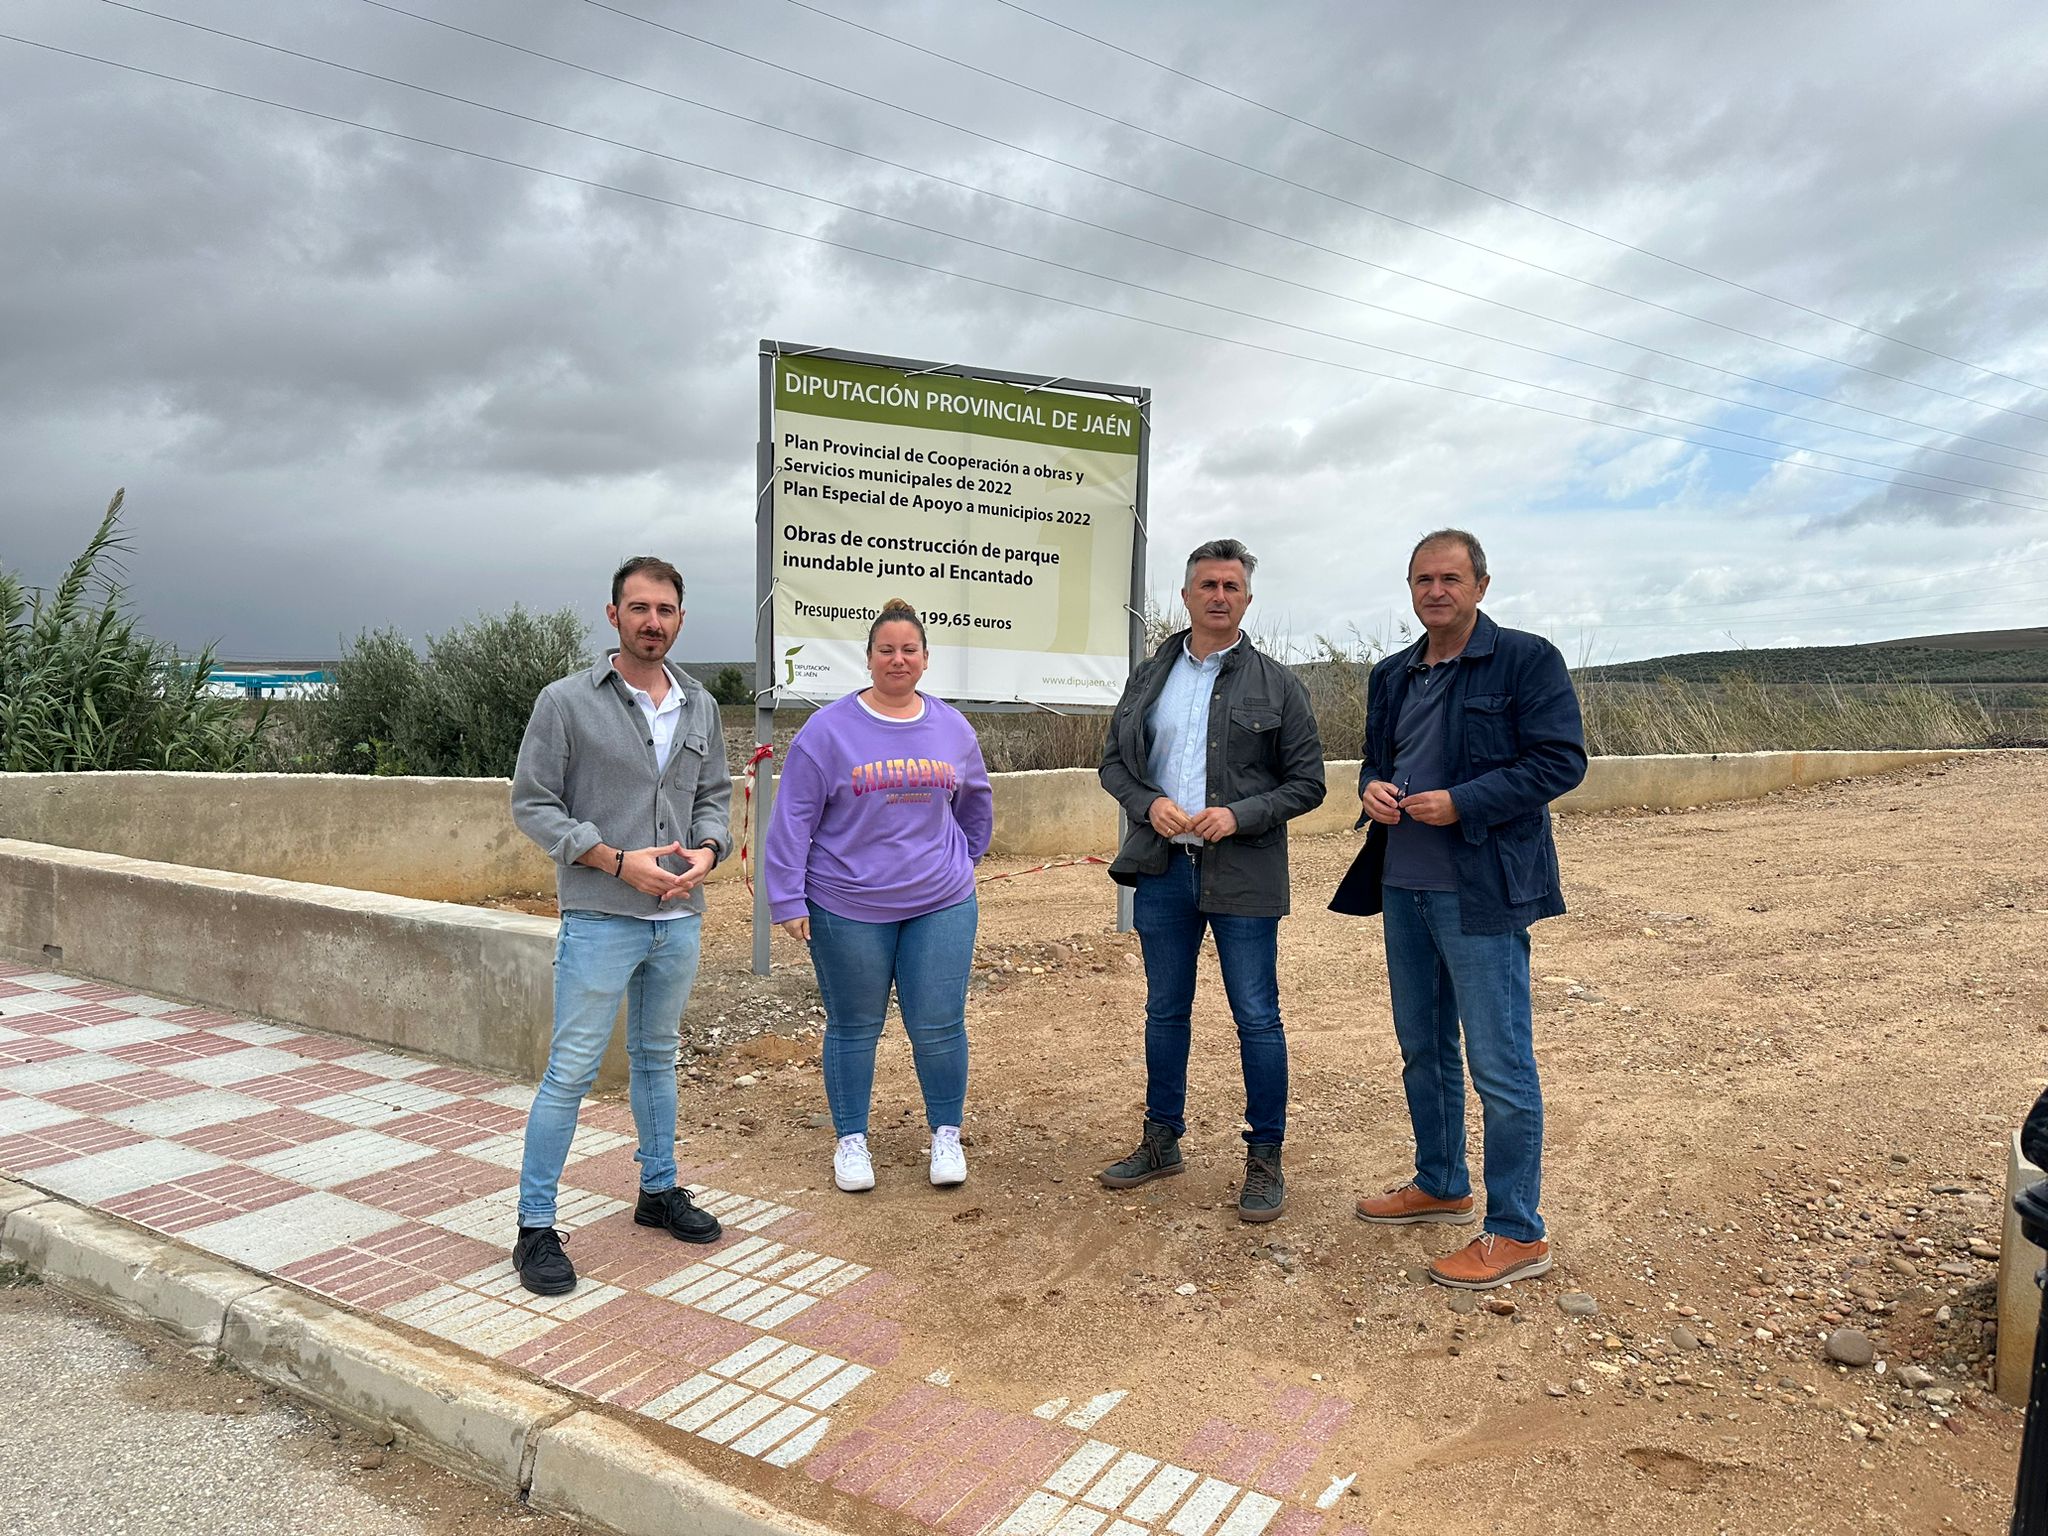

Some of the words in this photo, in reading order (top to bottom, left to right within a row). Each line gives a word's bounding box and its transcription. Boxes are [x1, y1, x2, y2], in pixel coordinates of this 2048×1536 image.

[785, 373, 919, 408] DIPUTACIÓN
[927, 392, 1045, 426] PROVINCIAL
[1052, 410, 1077, 430] DE
[1082, 415, 1131, 437] JAÉN
[784, 457, 855, 478] Servicios
[859, 468, 952, 491] municipales
[957, 476, 975, 491] de
[978, 479, 1012, 495] 2022
[785, 433, 819, 451] Plan
[824, 439, 900, 460] Provincial
[904, 446, 924, 463] de
[928, 451, 1018, 475] Cooperación
[1023, 463, 1030, 474] a
[1034, 463, 1072, 481] obras
[1075, 470, 1084, 484] y
[784, 481, 818, 498] Plan
[822, 486, 885, 506] Especial
[889, 492, 909, 506] de
[912, 497, 963, 516] Apoyo
[967, 501, 974, 513] a
[978, 502, 1053, 524] municipios
[1057, 511, 1090, 526] 2022
[784, 525, 836, 545] Obras
[841, 530, 862, 547] de
[867, 534, 978, 556] construcción
[982, 543, 1001, 558] de
[1005, 547, 1060, 567] parque
[784, 552, 873, 573] inundable
[877, 561, 925, 579] junto
[929, 564, 944, 578] al
[950, 565, 1033, 586] Encantado
[974, 616, 1012, 630] euros
[1042, 676, 1117, 688] www.dipujaen.es
